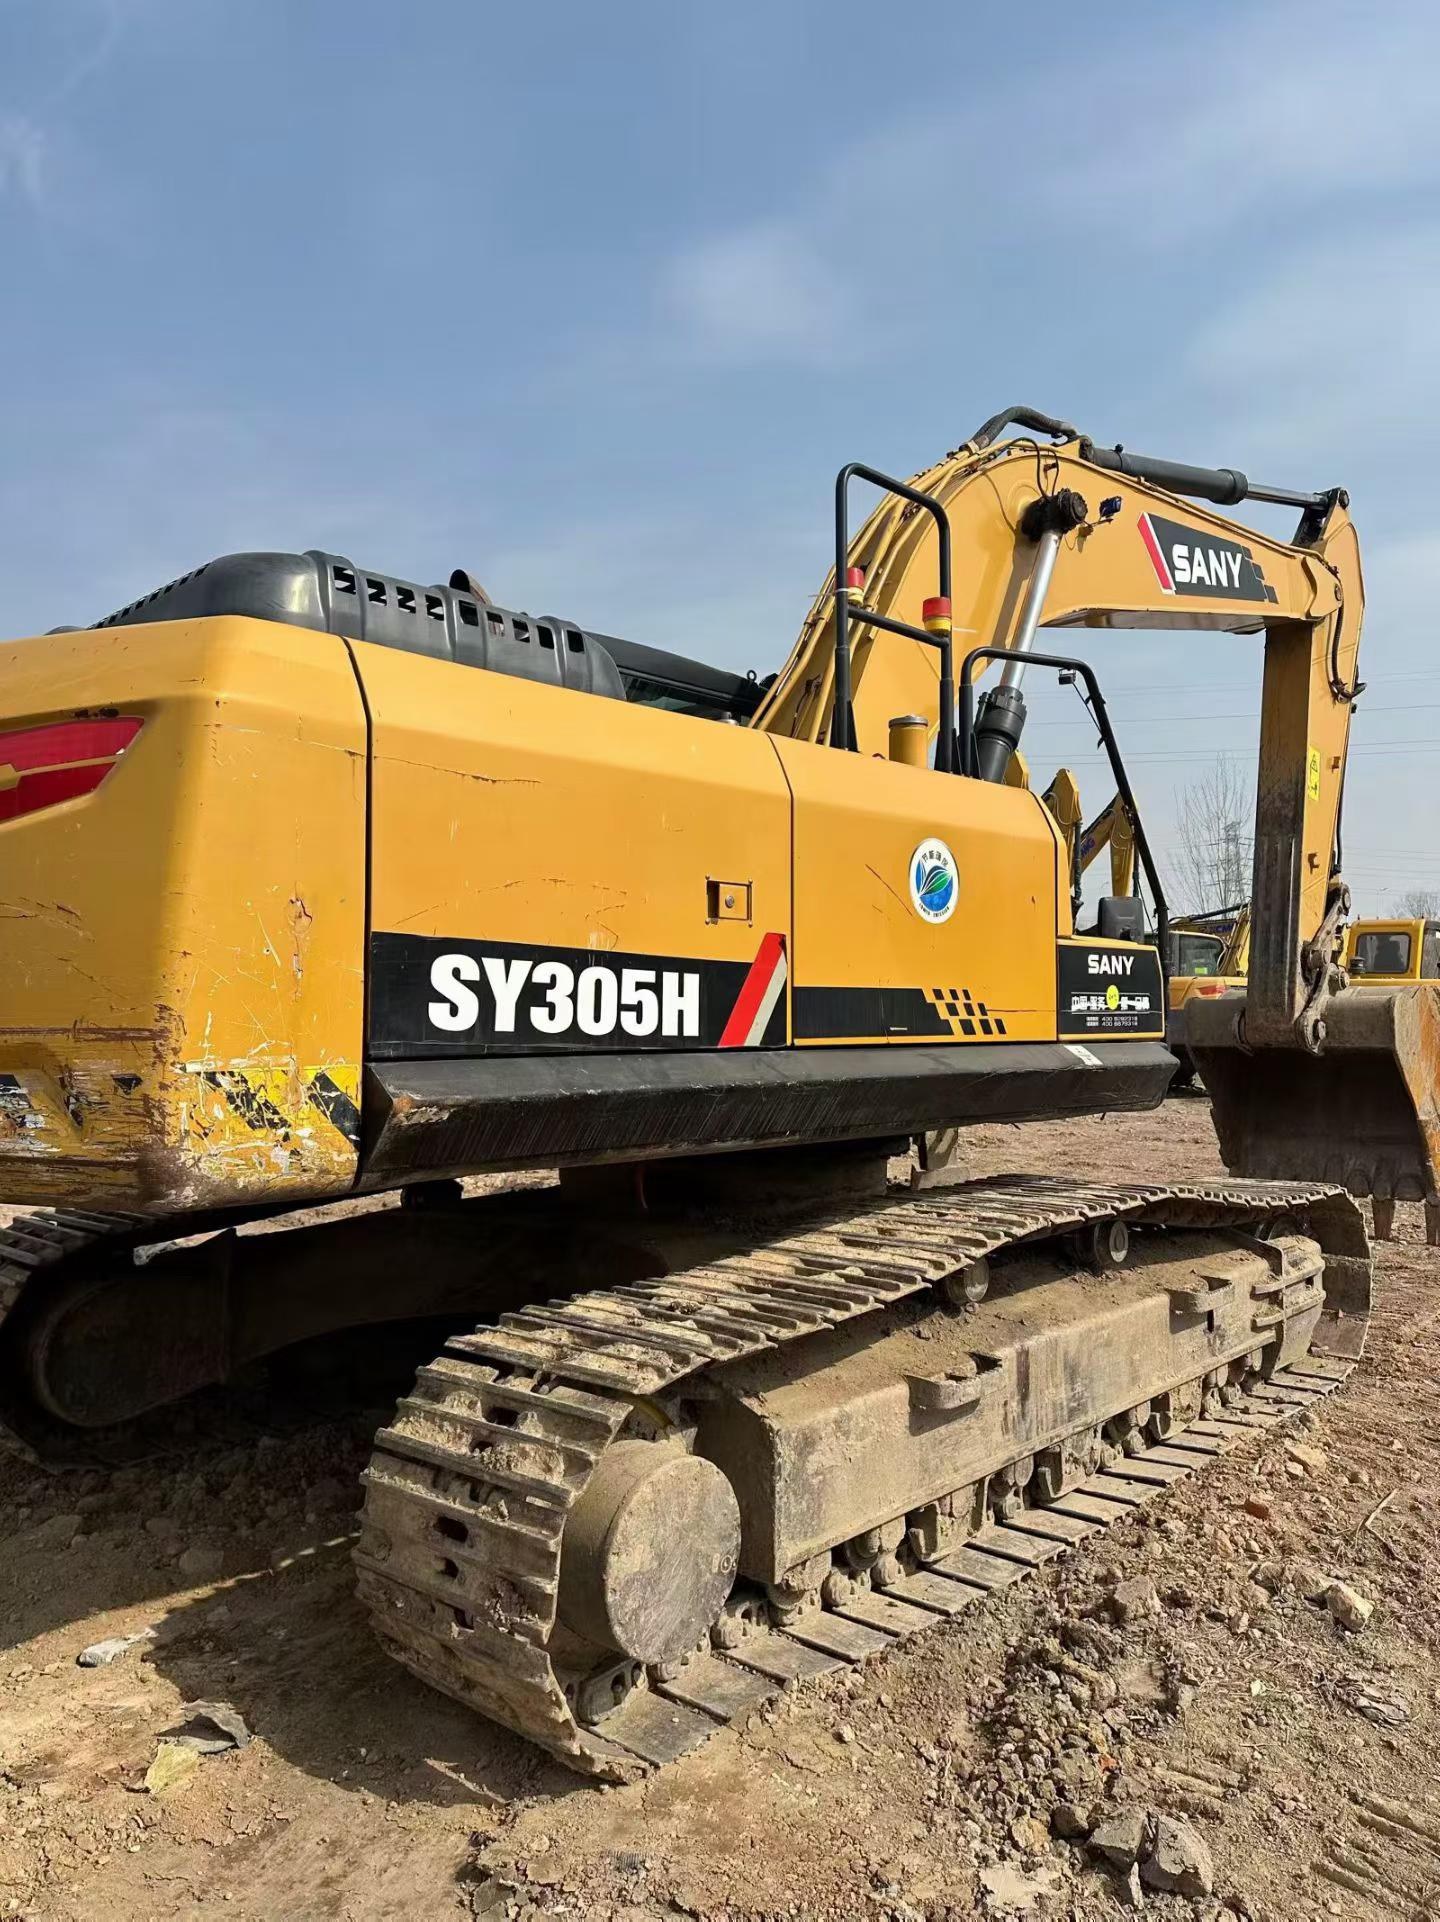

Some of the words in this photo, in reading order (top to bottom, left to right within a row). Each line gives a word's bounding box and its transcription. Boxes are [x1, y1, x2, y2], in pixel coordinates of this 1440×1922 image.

[1172, 544, 1242, 588] SANY
[1088, 954, 1134, 975] SANY
[428, 954, 700, 1037] SY305H
